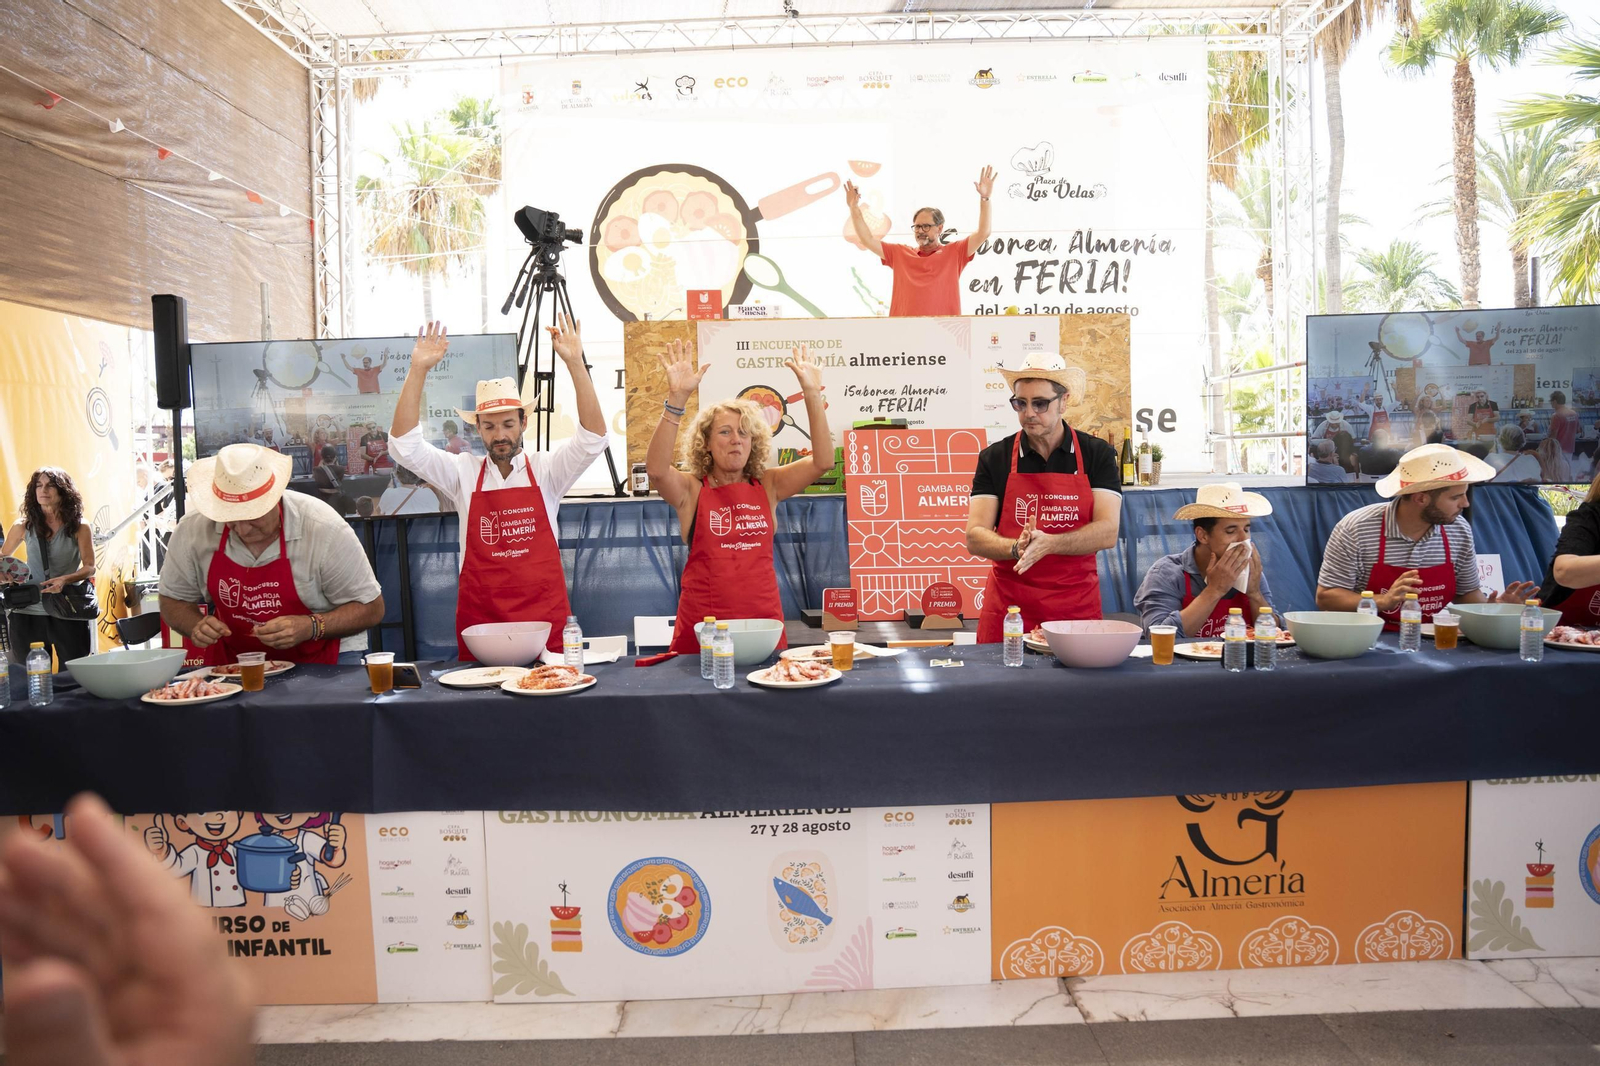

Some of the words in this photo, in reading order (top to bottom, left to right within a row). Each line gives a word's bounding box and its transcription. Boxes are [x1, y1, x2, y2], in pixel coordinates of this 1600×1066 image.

[714, 76, 748, 89] eco
[858, 75, 893, 83] BOSQUET
[1034, 176, 1056, 184] Plaza
[1027, 182, 1048, 201] Las
[1054, 182, 1095, 199] Velas
[969, 276, 1003, 295] en
[1014, 258, 1132, 294] FERIA!
[975, 304, 998, 315] del
[1024, 304, 1038, 315] al
[1042, 306, 1060, 314] 30
[736, 341, 750, 350] III
[752, 340, 825, 350] ENCUENTRO
[826, 340, 842, 348] DE
[1520, 334, 1563, 346] FERIA!
[850, 352, 947, 368] almeriense
[985, 382, 1004, 390] eco
[860, 403, 874, 413] en
[878, 397, 928, 414] FERIA!
[917, 484, 954, 493] GAMBA
[918, 496, 969, 507] ALMER
[502, 506, 534, 516] CONCURSO
[1040, 512, 1079, 521] ALMERÍA
[502, 524, 536, 537] ALMERÍA
[736, 520, 768, 530] ALMERÍA
[242, 582, 280, 592] CONCURSO
[242, 598, 282, 610] ALMERÍA
[1420, 601, 1443, 611] MERÍA
[884, 812, 914, 822] eco
[378, 826, 408, 836] eco
[439, 828, 469, 836] BOSQUET
[750, 823, 766, 835] 27
[770, 824, 780, 836] y
[782, 822, 798, 834] 28
[802, 820, 852, 835] agosto
[1158, 860, 1305, 900] Almería
[1158, 904, 1206, 914] Asociación
[1209, 902, 1242, 910] Almería
[1246, 900, 1305, 910] Gastronómica
[272, 921, 290, 932] DE
